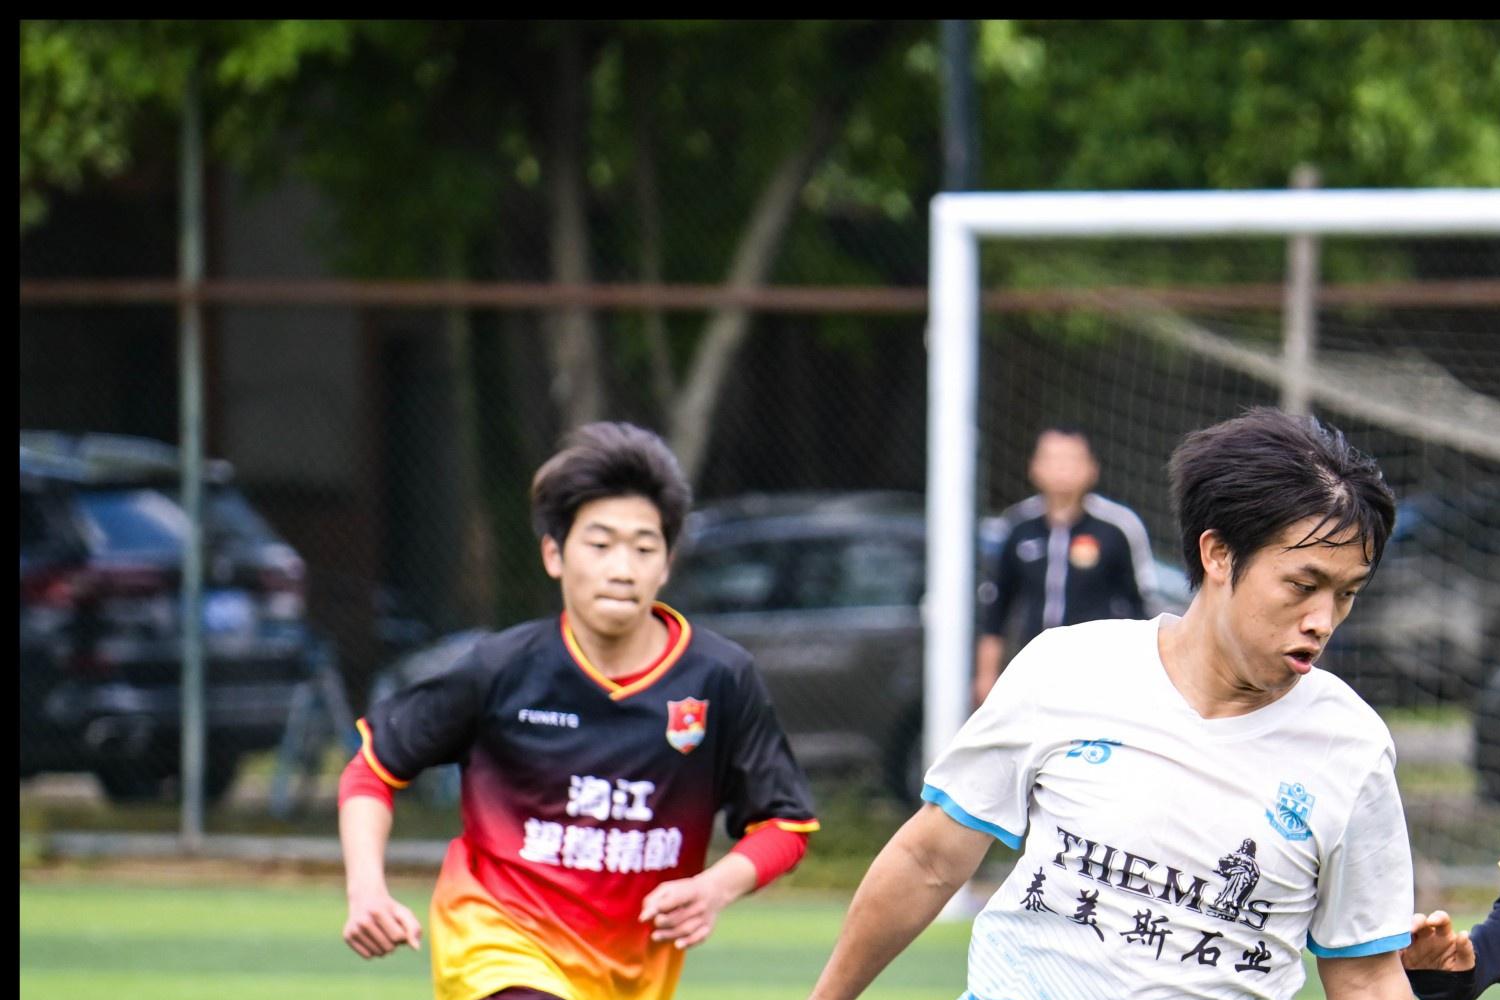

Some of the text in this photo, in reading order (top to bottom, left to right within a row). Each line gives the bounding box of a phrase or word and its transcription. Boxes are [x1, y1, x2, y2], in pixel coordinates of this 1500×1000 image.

[1020, 866, 1271, 973] 泰美斯石业
